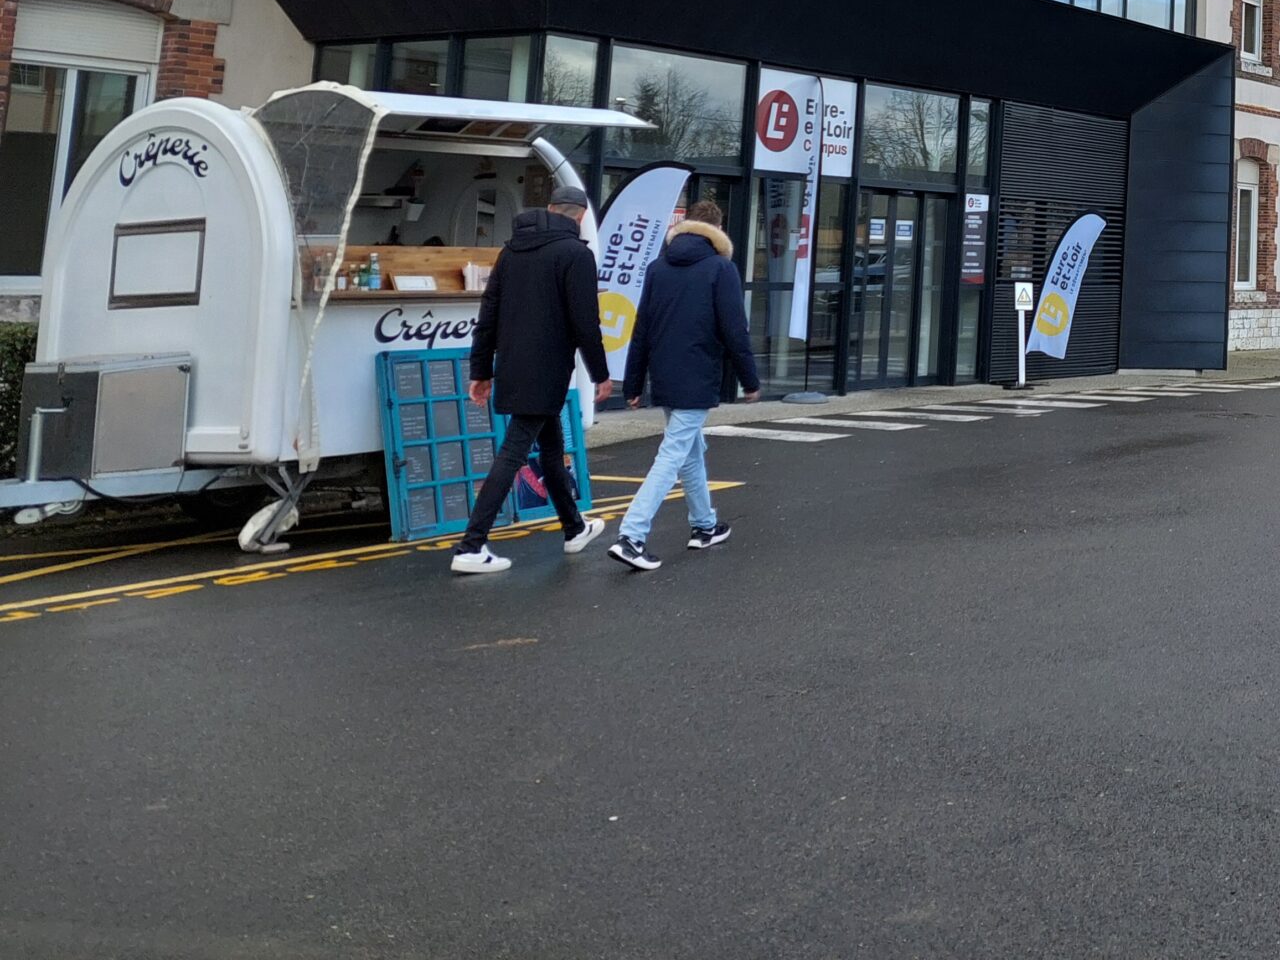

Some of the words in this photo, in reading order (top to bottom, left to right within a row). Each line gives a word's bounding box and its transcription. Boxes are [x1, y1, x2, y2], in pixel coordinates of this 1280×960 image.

[804, 120, 853, 139] e-Loir
[806, 99, 844, 118] Ere-
[119, 133, 208, 187] Crêperie
[598, 223, 624, 283] Eure-
[617, 214, 650, 285] et-Loir
[638, 219, 662, 277] DÉPARTEMENT
[1050, 245, 1071, 286] Eure-
[1060, 241, 1083, 290] et-Loir
[374, 307, 480, 350] Crêper
